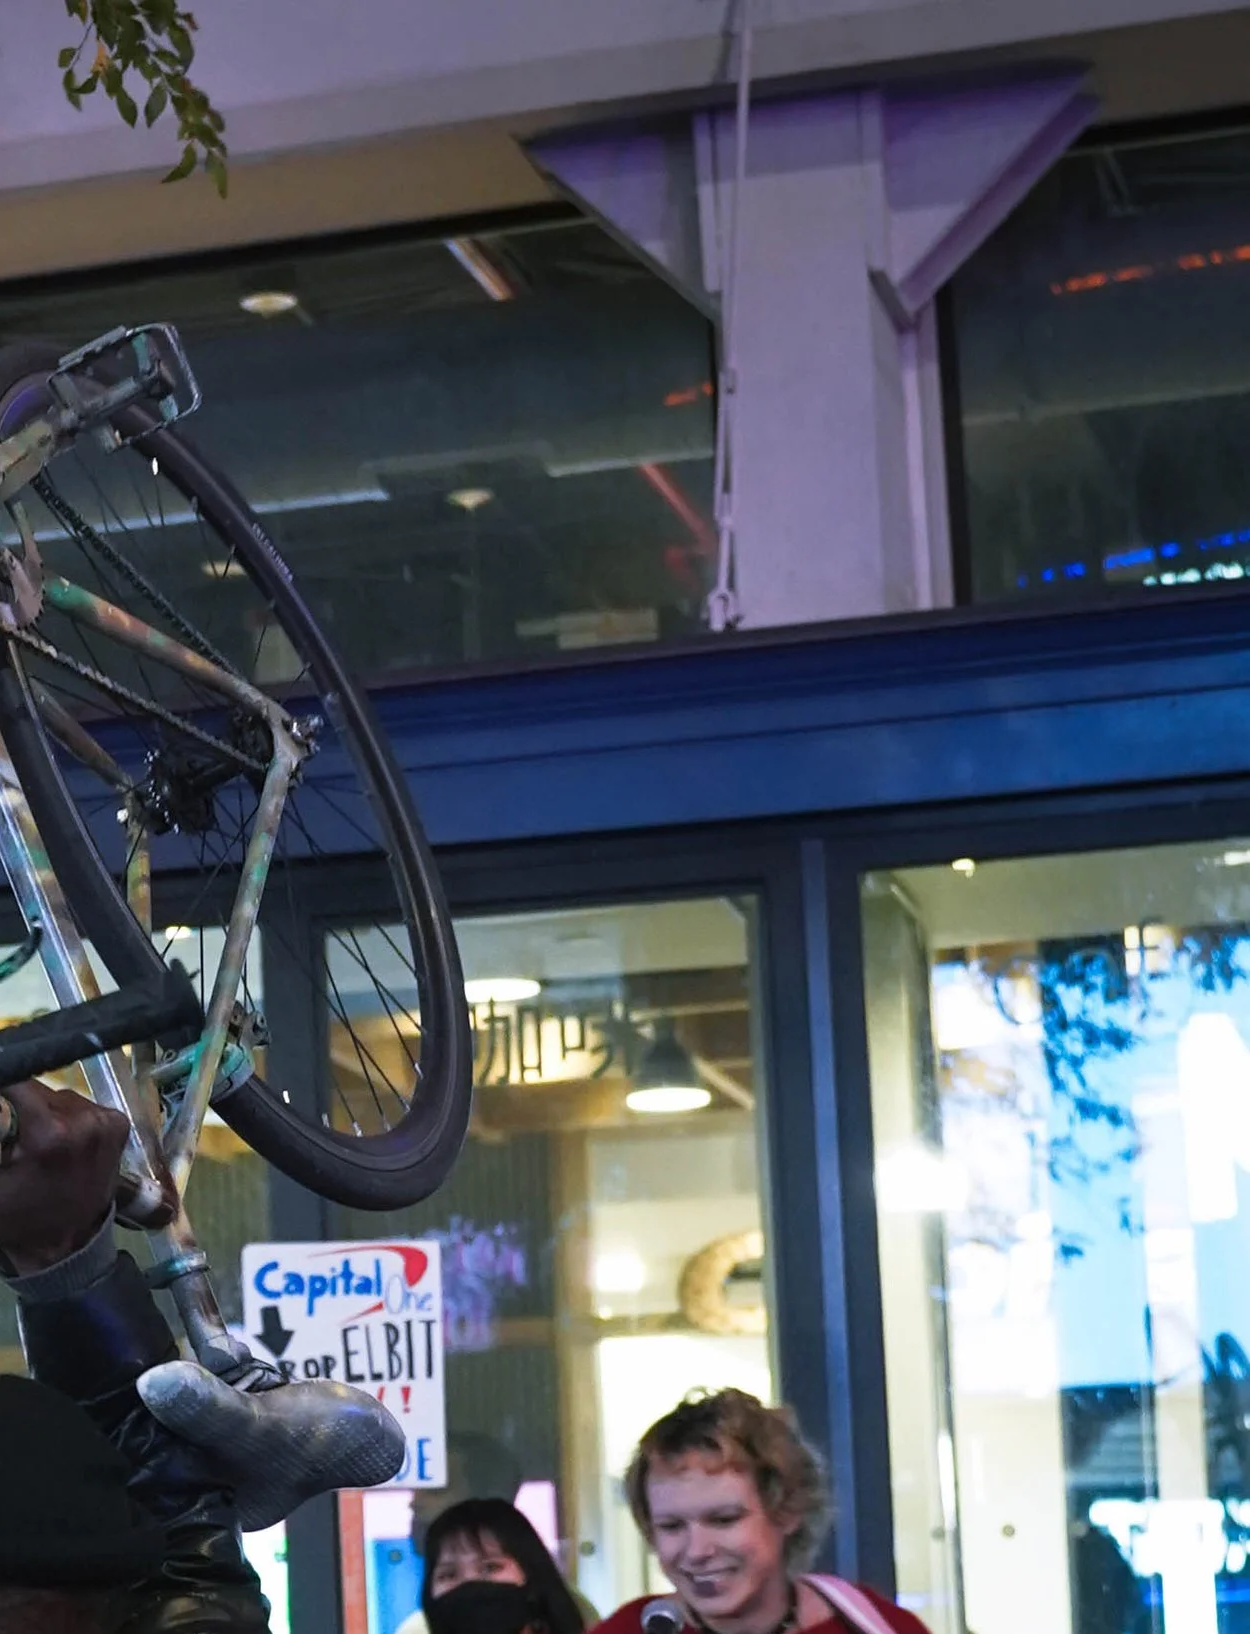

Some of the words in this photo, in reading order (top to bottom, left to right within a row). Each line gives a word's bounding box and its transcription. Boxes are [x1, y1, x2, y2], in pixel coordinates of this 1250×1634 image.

[254, 1258, 382, 1317] Capital
[385, 1273, 433, 1315] One
[276, 1354, 338, 1380] ROP
[342, 1319, 437, 1383] ELBIT
